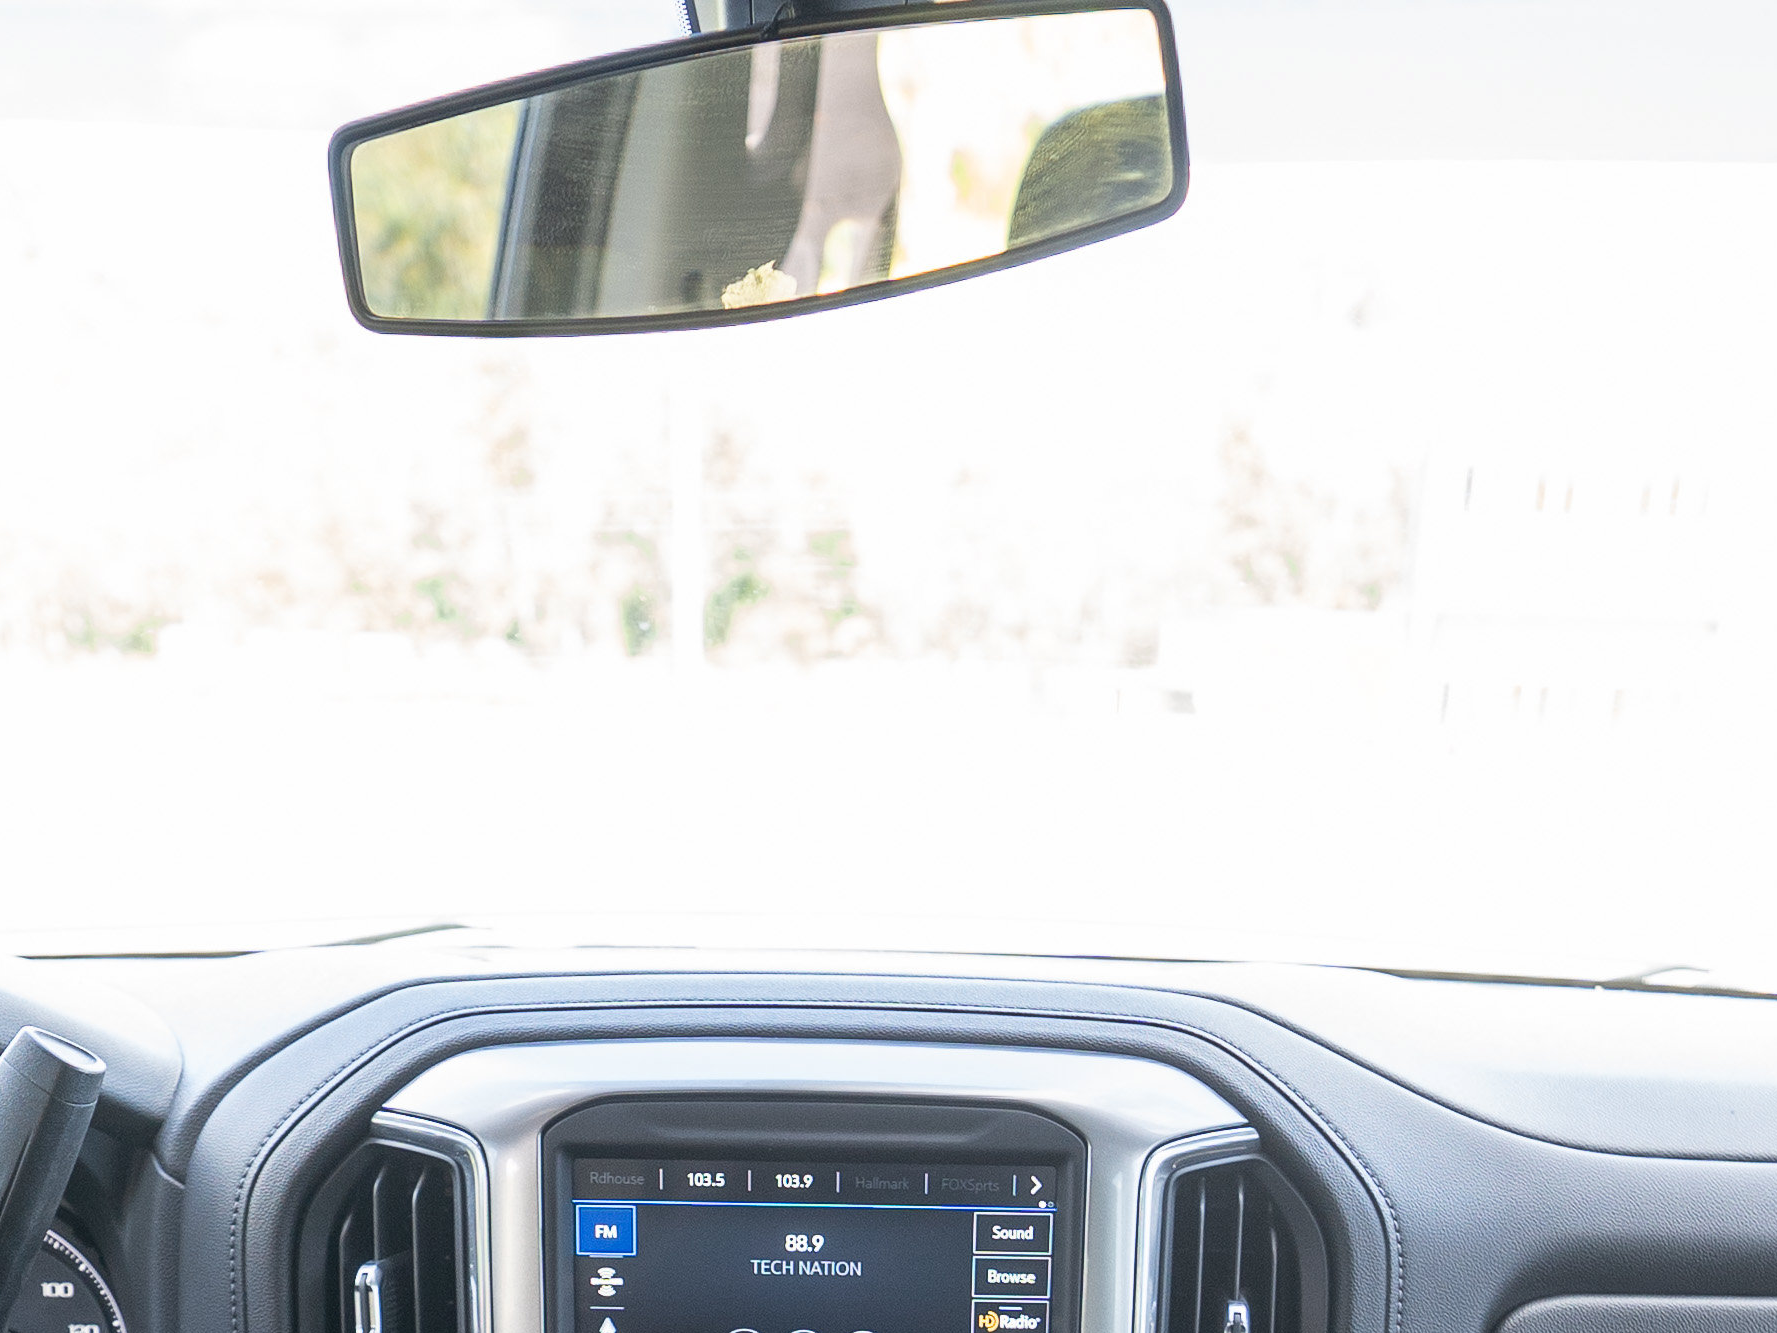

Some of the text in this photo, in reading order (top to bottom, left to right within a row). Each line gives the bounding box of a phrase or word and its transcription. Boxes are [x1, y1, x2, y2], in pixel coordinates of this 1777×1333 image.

[589, 1171, 645, 1187] Rdhouse
[687, 1172, 726, 1188] 103.5
[775, 1174, 814, 1189] 103.9
[854, 1176, 910, 1191] Hallmark
[941, 1177, 1000, 1193] FOXSprts
[594, 1224, 618, 1239] FM
[991, 1225, 1034, 1241] Sound
[785, 1234, 825, 1252] 88.9
[750, 1259, 862, 1276] TECH NATION
[987, 1268, 1036, 1284] Browse
[40, 1281, 75, 1298] 100
